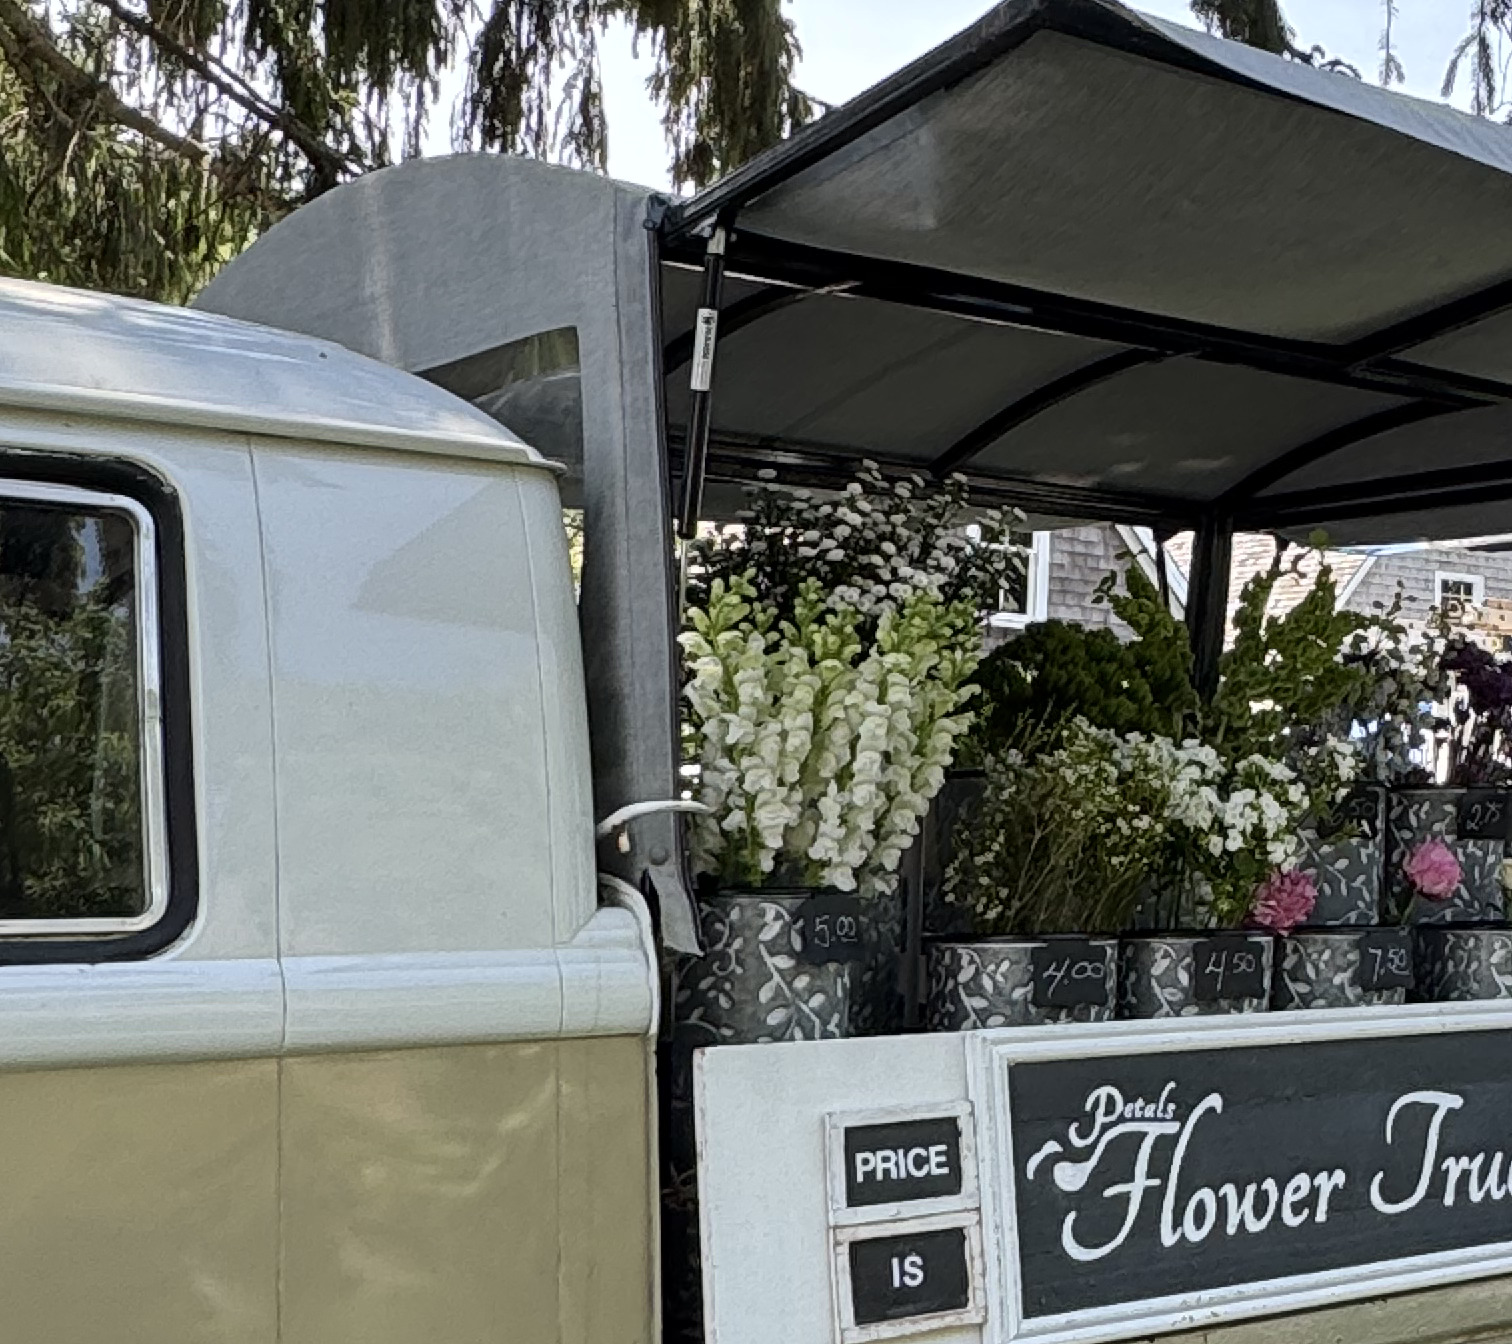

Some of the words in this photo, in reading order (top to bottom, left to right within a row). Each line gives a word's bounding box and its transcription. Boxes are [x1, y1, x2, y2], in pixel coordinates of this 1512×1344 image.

[1042, 956, 1107, 994] 4.00
[1368, 947, 1411, 984] 7.50
[1069, 1081, 1177, 1148] Petals
[854, 1144, 950, 1184] PRICE
[1050, 1092, 1347, 1262] Flower
[890, 1252, 925, 1289] IS
